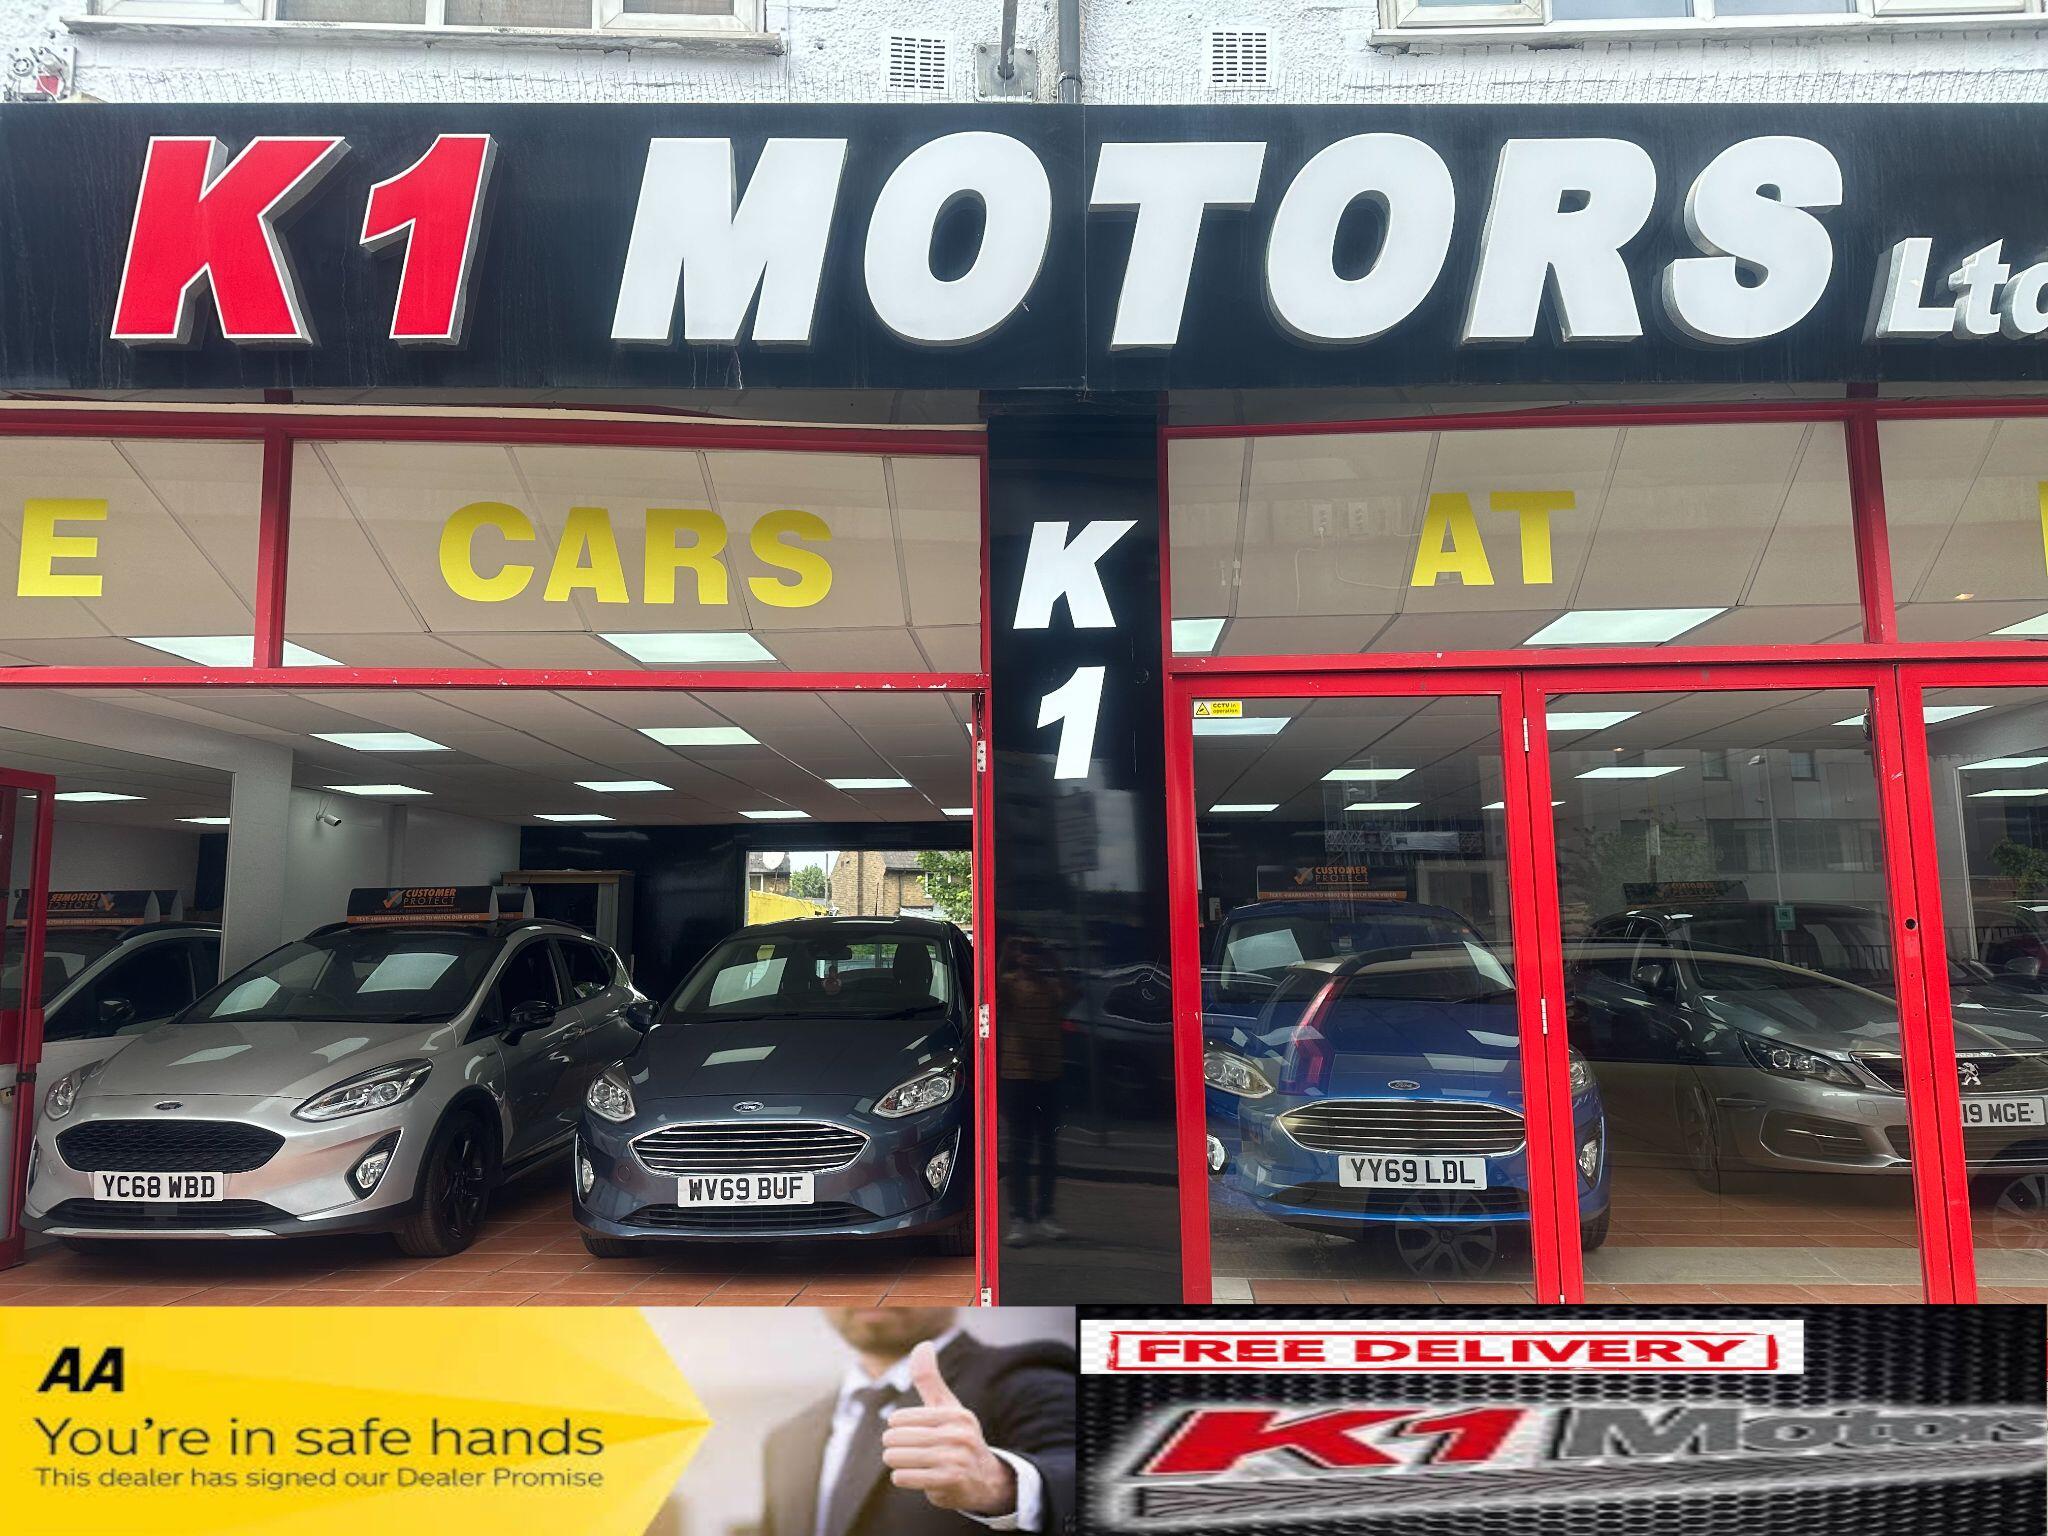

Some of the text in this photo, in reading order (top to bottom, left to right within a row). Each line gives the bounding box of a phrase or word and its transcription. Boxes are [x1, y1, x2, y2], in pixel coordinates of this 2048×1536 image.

[111, 133, 495, 346] K1
[610, 130, 1843, 349] MOTORS
[439, 500, 833, 609] CARS
[1411, 490, 1576, 587] AT
[1315, 866, 1368, 875] CUSTOMER
[1315, 874, 1369, 882] PROTECT
[403, 896, 455, 905] PROTECT
[405, 888, 457, 898] CUSTOMER
[1988, 1102, 2032, 1123] MGE
[1350, 1158, 1476, 1184] YY69 LDL
[102, 1174, 215, 1198] YC68 WBD
[688, 1176, 803, 1201] WV69 BUF
